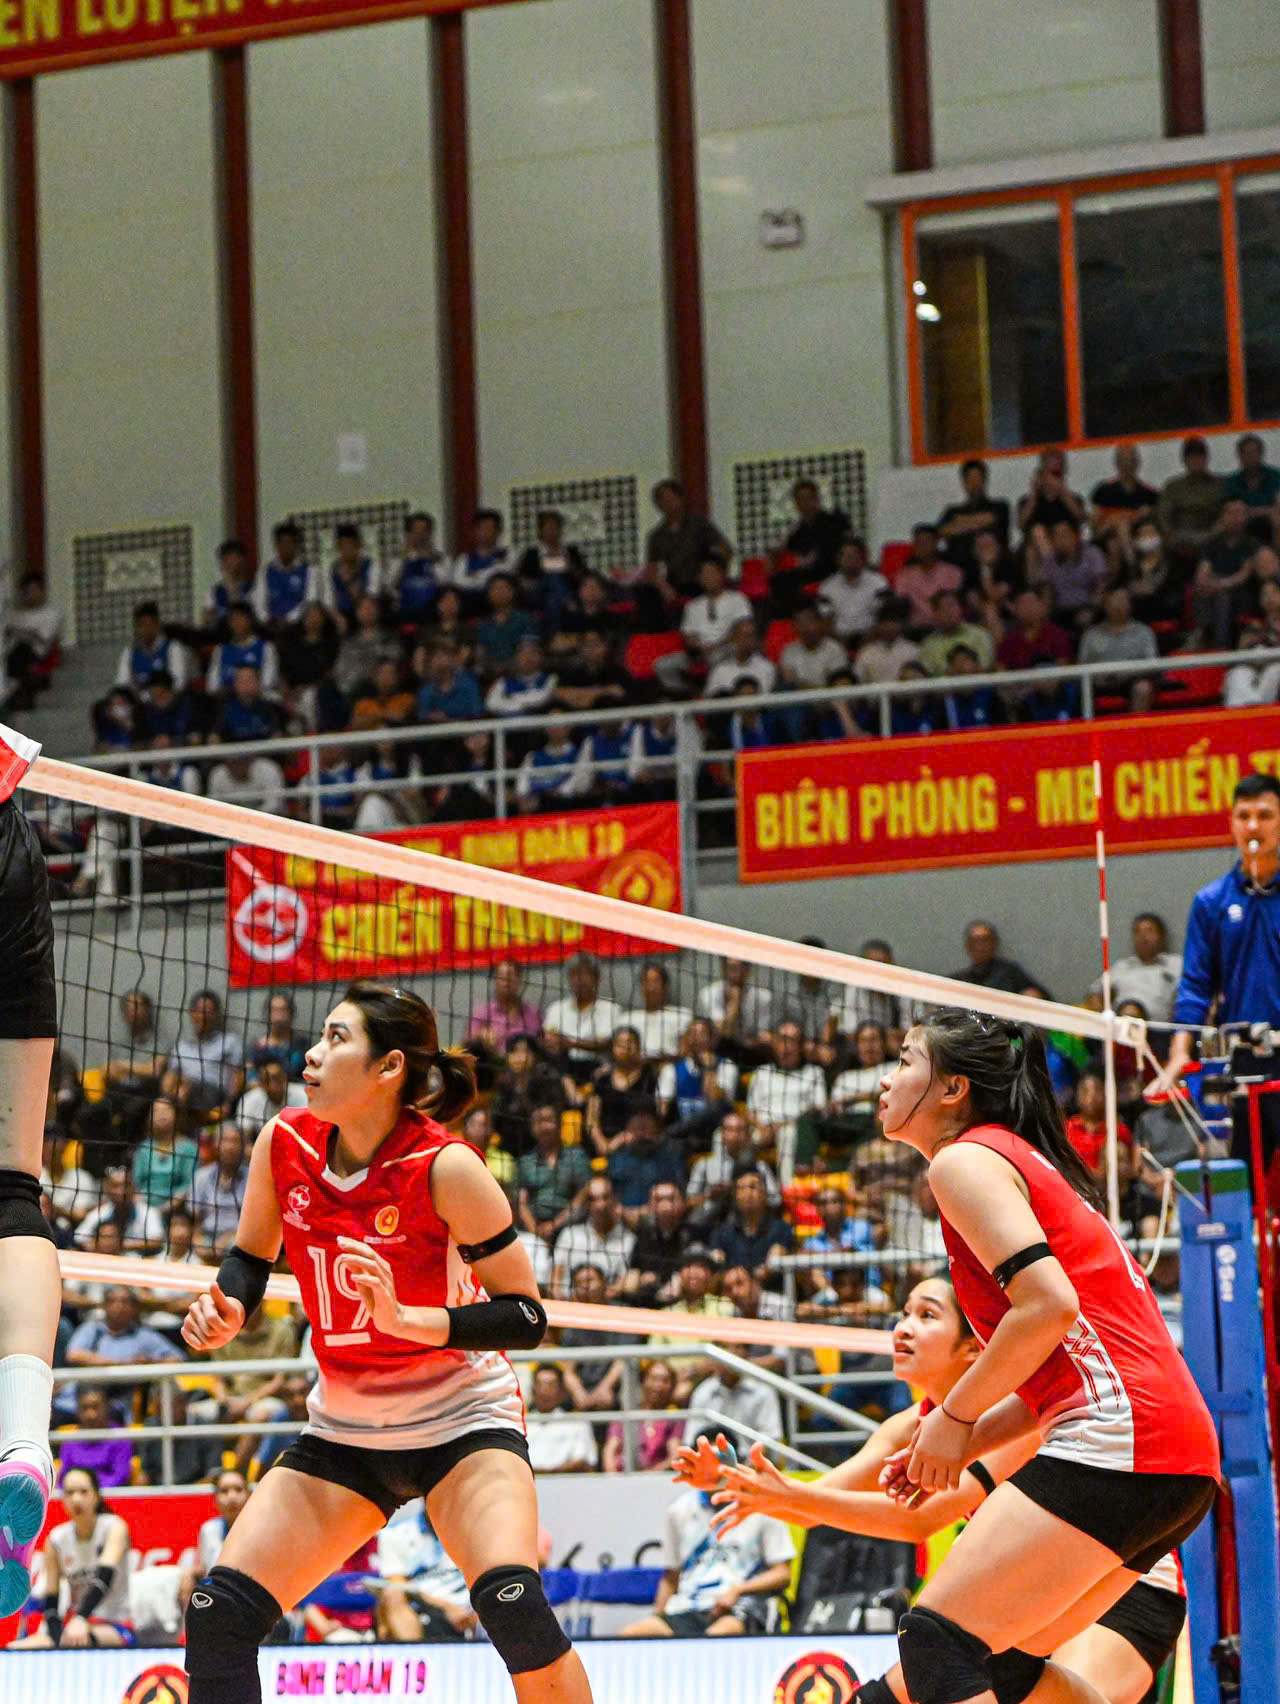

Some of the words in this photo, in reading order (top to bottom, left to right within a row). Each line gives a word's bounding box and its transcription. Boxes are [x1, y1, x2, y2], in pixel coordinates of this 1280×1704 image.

[755, 777, 849, 851] BIÊN
[858, 765, 999, 842] PHÒNG
[1113, 737, 1240, 822] CHIẾN
[306, 1245, 375, 1330] 19
